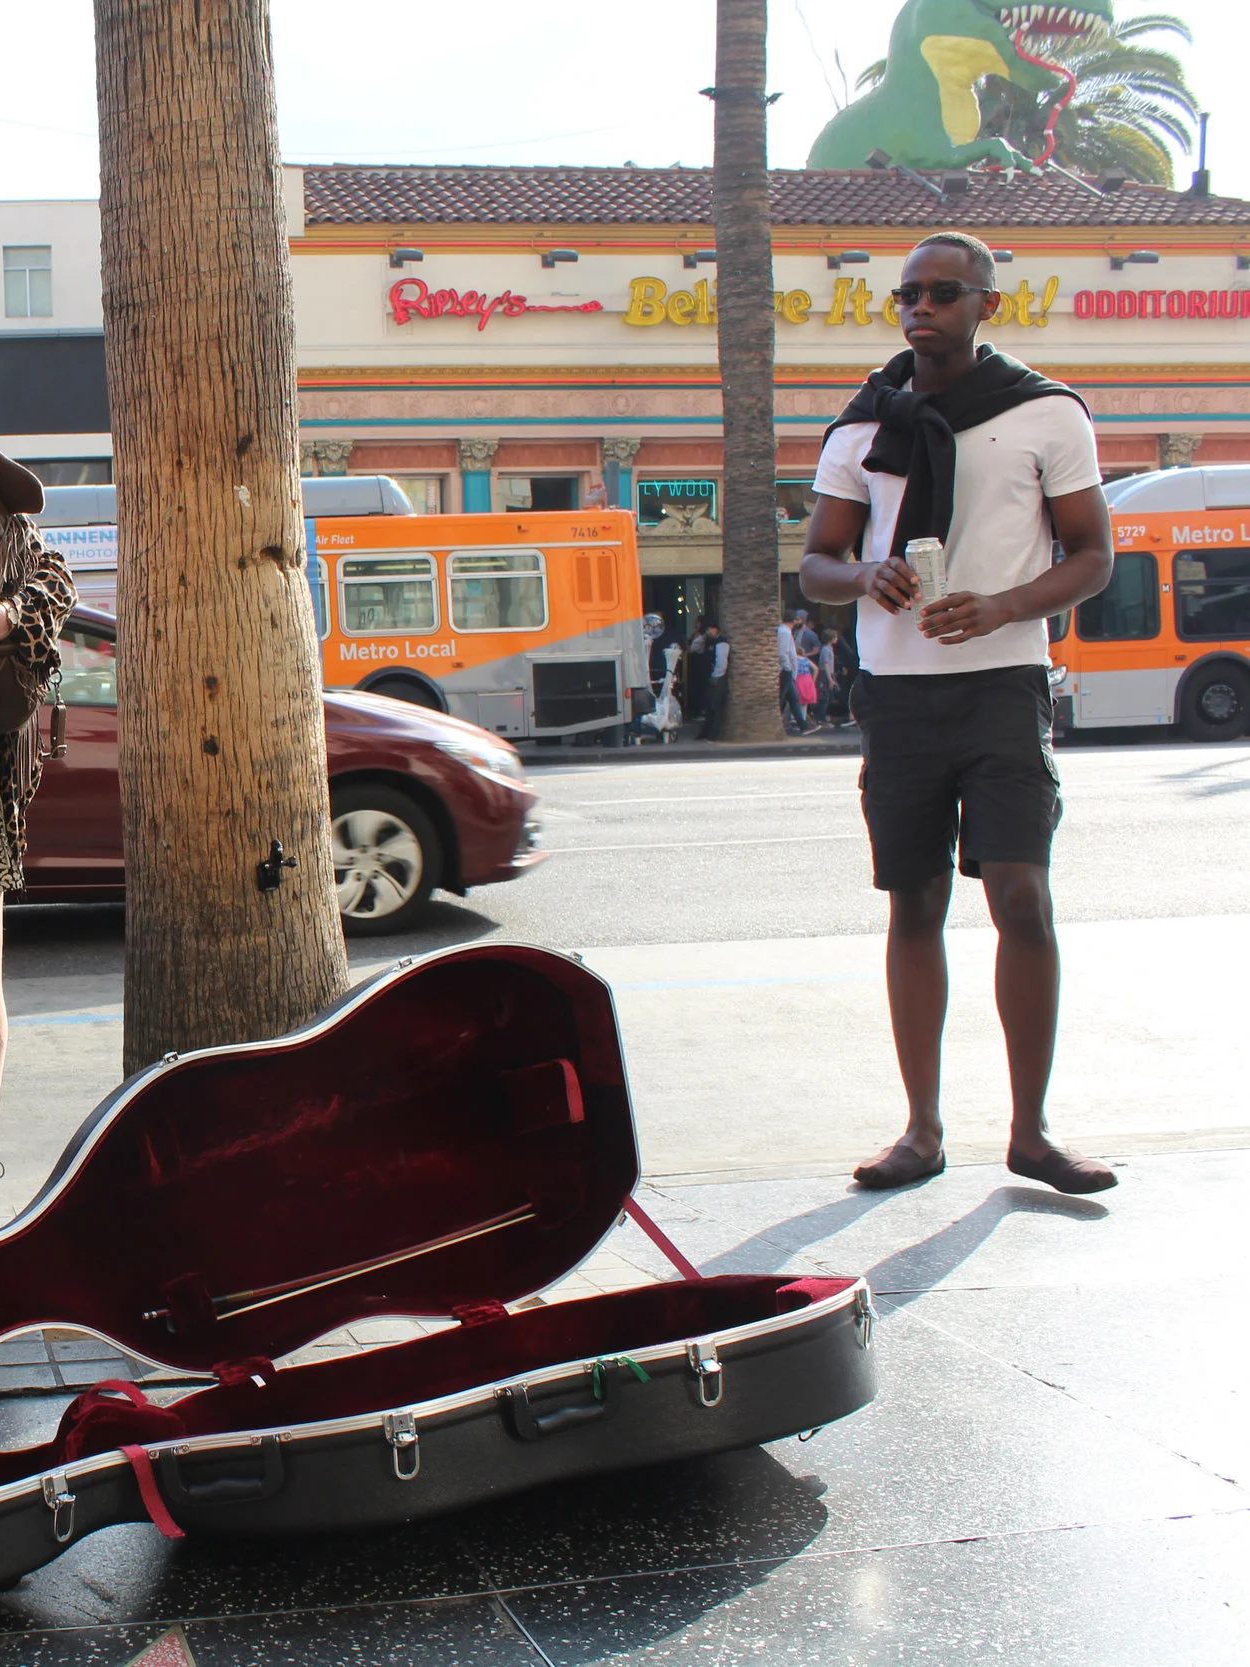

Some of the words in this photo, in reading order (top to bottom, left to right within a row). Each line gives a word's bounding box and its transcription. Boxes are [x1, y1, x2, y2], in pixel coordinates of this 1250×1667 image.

[623, 276, 812, 326] Bele
[825, 277, 872, 326] It
[45, 530, 117, 544] ANNEN
[571, 527, 599, 538] 7416
[1117, 525, 1147, 538] 5729
[1172, 525, 1235, 544] Metro
[315, 535, 329, 545] Air
[331, 534, 355, 545] Fleet
[340, 642, 399, 660] Metro
[405, 639, 456, 658] Local
